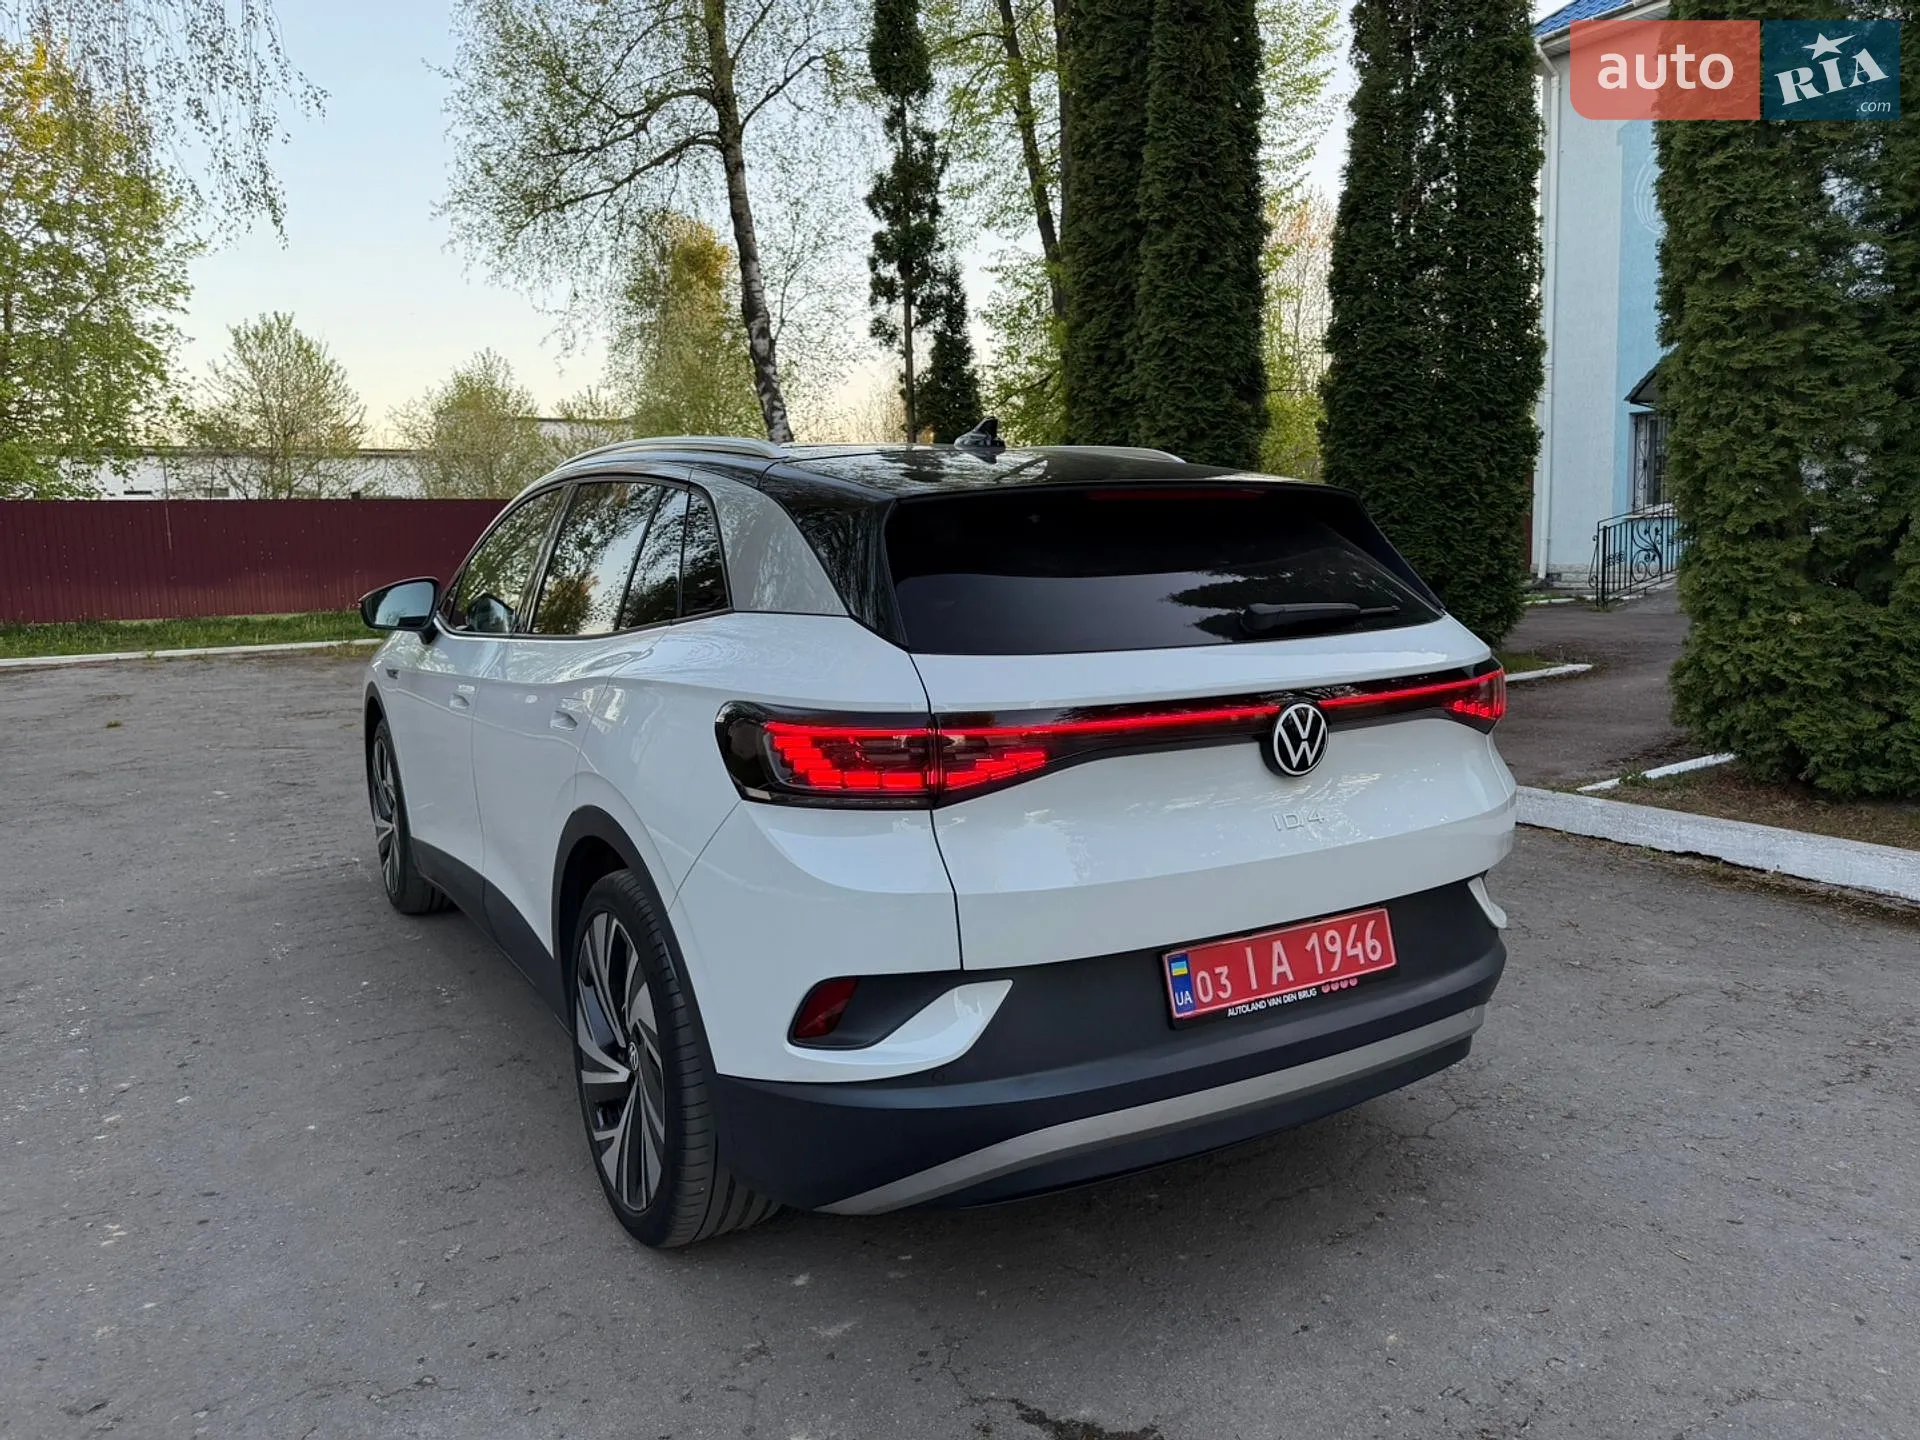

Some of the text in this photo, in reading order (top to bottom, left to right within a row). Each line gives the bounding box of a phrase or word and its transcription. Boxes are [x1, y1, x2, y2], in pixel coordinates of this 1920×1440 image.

[1196, 965, 1232, 1004] 03
[1305, 919, 1382, 975] 1946
[1175, 991, 1193, 1006] UA
[1227, 987, 1317, 1018] AUTOLAND VAN DEN BRUG
